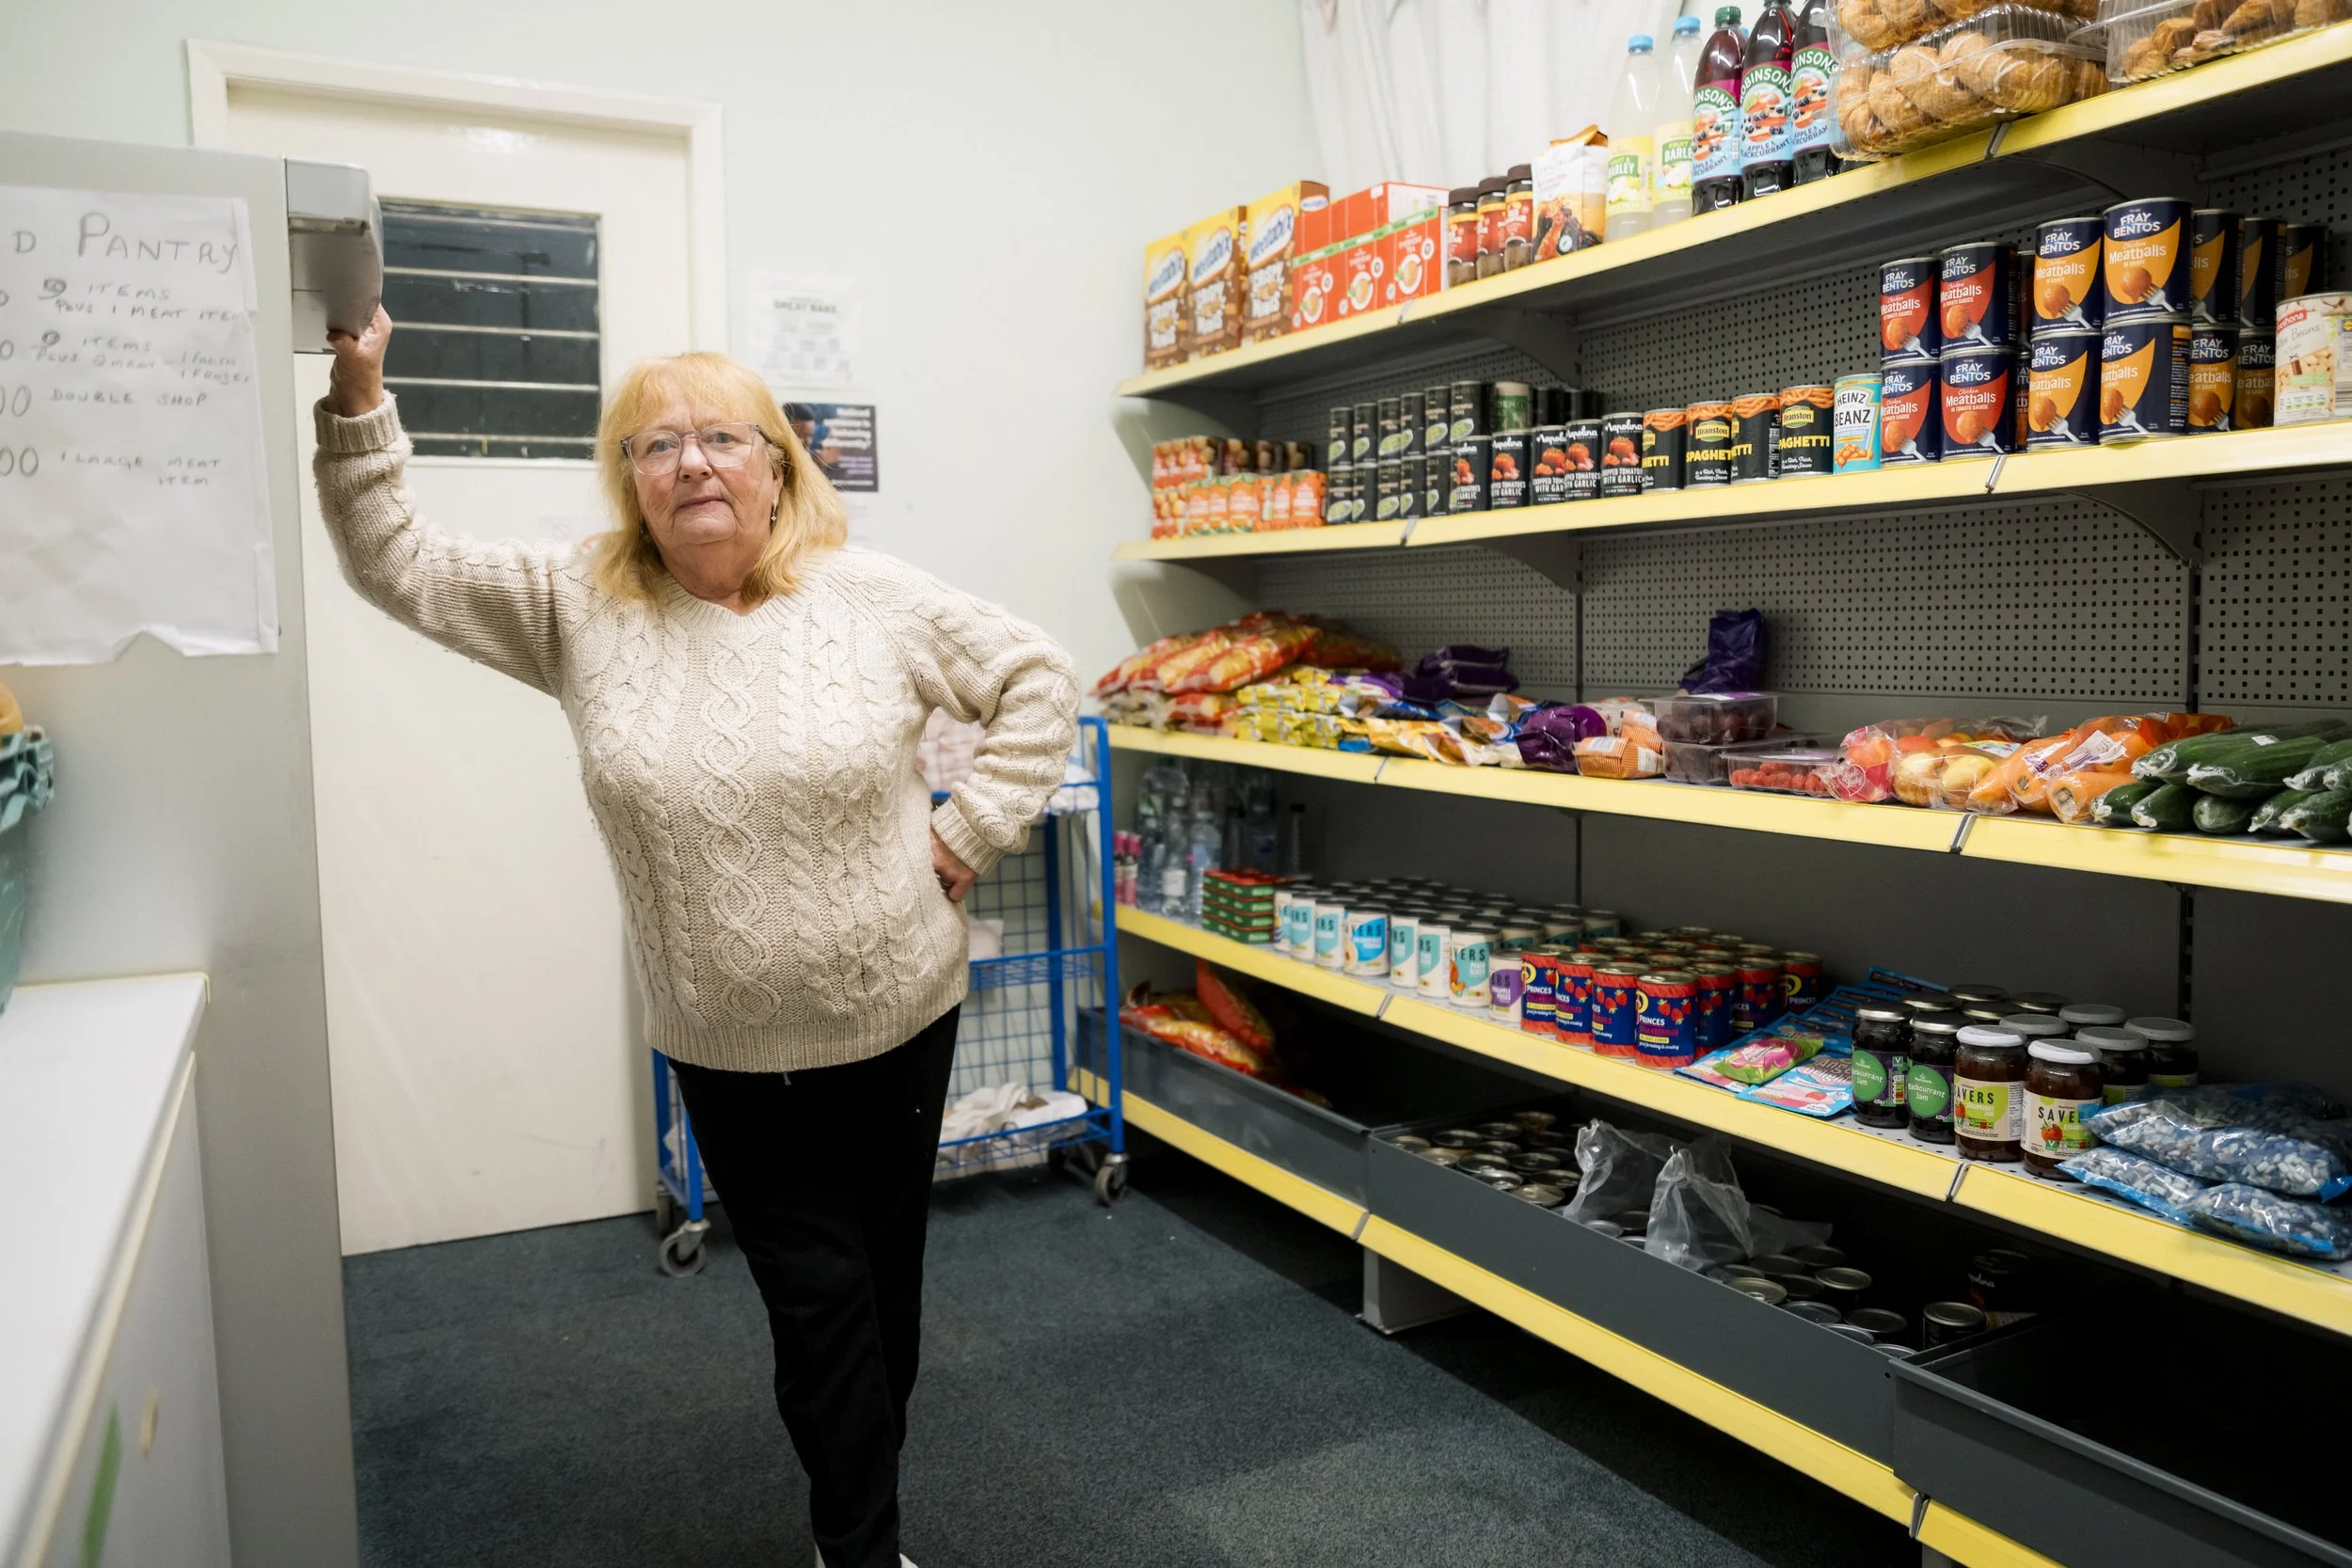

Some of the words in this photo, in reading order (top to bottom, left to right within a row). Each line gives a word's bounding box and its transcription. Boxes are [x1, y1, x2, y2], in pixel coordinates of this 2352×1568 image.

[2121, 212, 2152, 227] FRAY
[2113, 221, 2161, 239] BENTOS
[78, 212, 239, 275] PANTRY
[2044, 231, 2073, 245] FRAY
[2040, 240, 2081, 256] BENTOS
[2108, 245, 2167, 264] Meatballs
[1945, 256, 1968, 269] FRAY
[1885, 271, 1908, 283] FRAY
[1942, 263, 1977, 279] BENTOS
[2036, 263, 2086, 279] Meatballs
[1882, 277, 1915, 293] BENTOS
[87, 283, 172, 300] ITEMS
[131, 307, 190, 319] MEAT
[83, 337, 153, 352] ITEMS
[2104, 335, 2125, 347] FRAY
[2192, 338, 2223, 349] FRAY
[2035, 345, 2058, 356] FRAY
[2242, 344, 2271, 356] FRAY
[1955, 362, 1984, 374] FRAY
[1884, 374, 1906, 385] FRAY
[1949, 371, 1992, 385] BENTOS
[49, 388, 135, 404] DOUBLE
[156, 391, 208, 406] SHOP
[1837, 392, 1867, 407] HEINZ
[1946, 392, 1996, 407] Meatballs
[1783, 411, 1812, 421] Branston
[1836, 408, 1871, 427] BEANZ
[1605, 419, 1644, 434] Napolina
[1697, 426, 1728, 436] Branston
[74, 456, 145, 470] LARGE
[167, 458, 222, 468] MEAT
[157, 474, 210, 486] ITEM
[1502, 481, 1526, 489] TOMATOES
[1574, 480, 1597, 488] GARLIC
[1603, 476, 1616, 484] WITH
[1616, 475, 1642, 483] GARLIC
[1501, 488, 1522, 497] GARLIC
[1535, 484, 1549, 493] WITH
[1526, 985, 1552, 994] PRINCES
[1639, 1014, 1665, 1026] PRINCES
[1915, 1092, 1930, 1102] Jam
